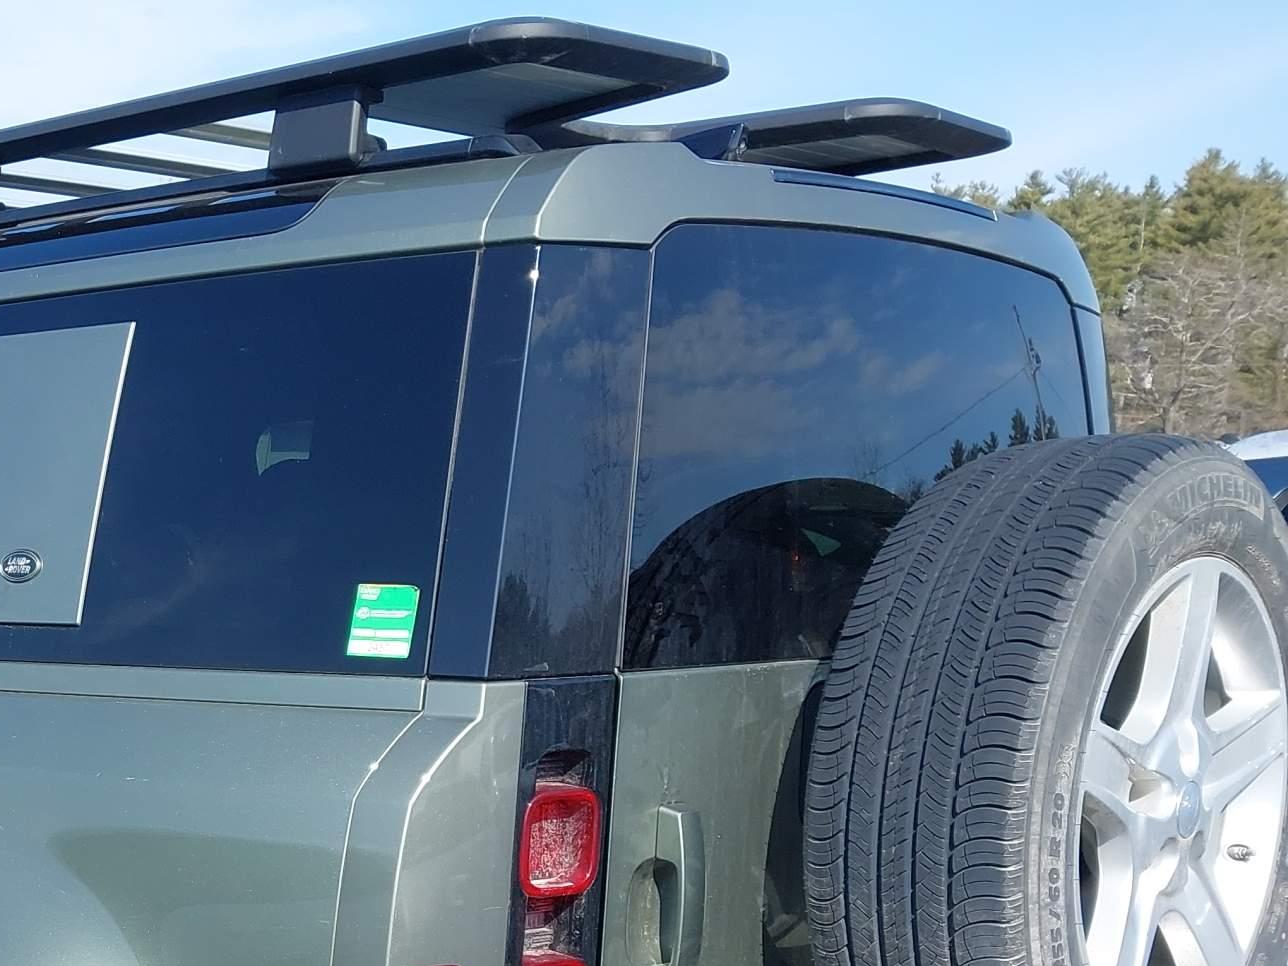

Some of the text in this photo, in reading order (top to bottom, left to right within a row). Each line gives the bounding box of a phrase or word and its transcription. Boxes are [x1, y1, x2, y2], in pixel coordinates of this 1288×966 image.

[1169, 472, 1264, 515] MICHELIN
[8, 556, 27, 565] LAND
[8, 565, 31, 574] ROVER
